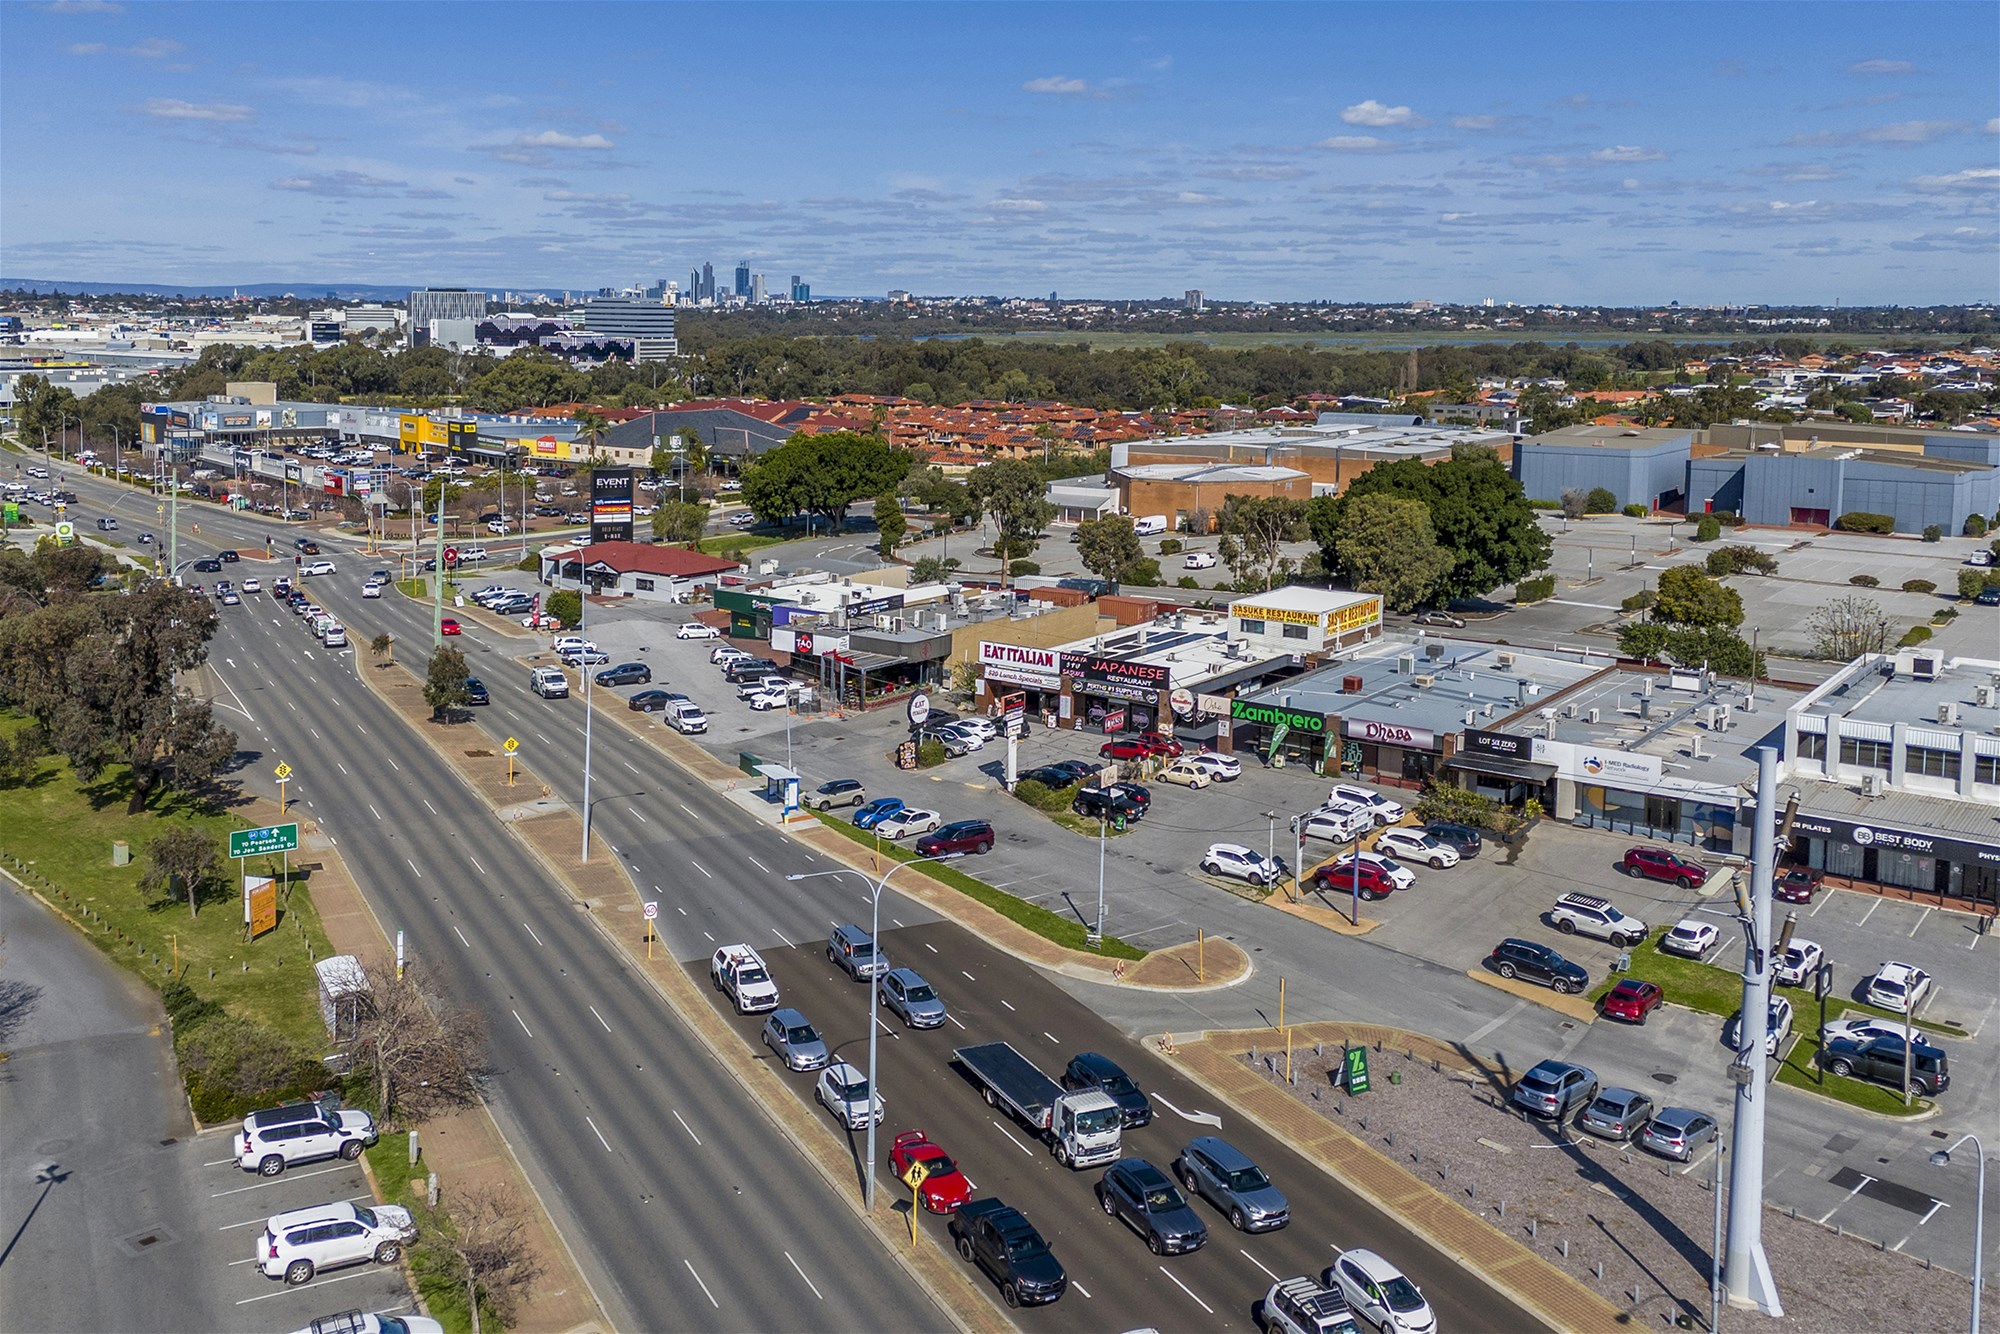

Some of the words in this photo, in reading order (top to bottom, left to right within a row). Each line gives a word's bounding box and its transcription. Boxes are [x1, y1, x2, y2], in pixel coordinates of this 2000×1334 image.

[596, 477, 629, 486] EVENT
[1232, 605, 1264, 615] SASUKE
[1266, 608, 1320, 621] RESTAURANT
[795, 639, 812, 649] TAO
[984, 644, 1006, 660] EAT
[1007, 647, 1054, 667] ITALIAN
[1091, 661, 1165, 680] JAPANESE
[999, 671, 1018, 680] Lunch
[1018, 674, 1043, 685] Specials
[1106, 674, 1152, 687] RESTAURANT
[1115, 686, 1143, 697] SUPPLIER
[914, 700, 925, 708] EAT
[1231, 701, 1323, 731] Zambrero
[1500, 741, 1517, 749] ZERO
[1622, 762, 1650, 772] Radiology
[1801, 822, 1831, 833] PILATES
[250, 838, 276, 846] Pearson
[1874, 832, 1902, 844] BEST
[1903, 836, 1933, 849] BODY
[258, 843, 285, 852] Sanders
